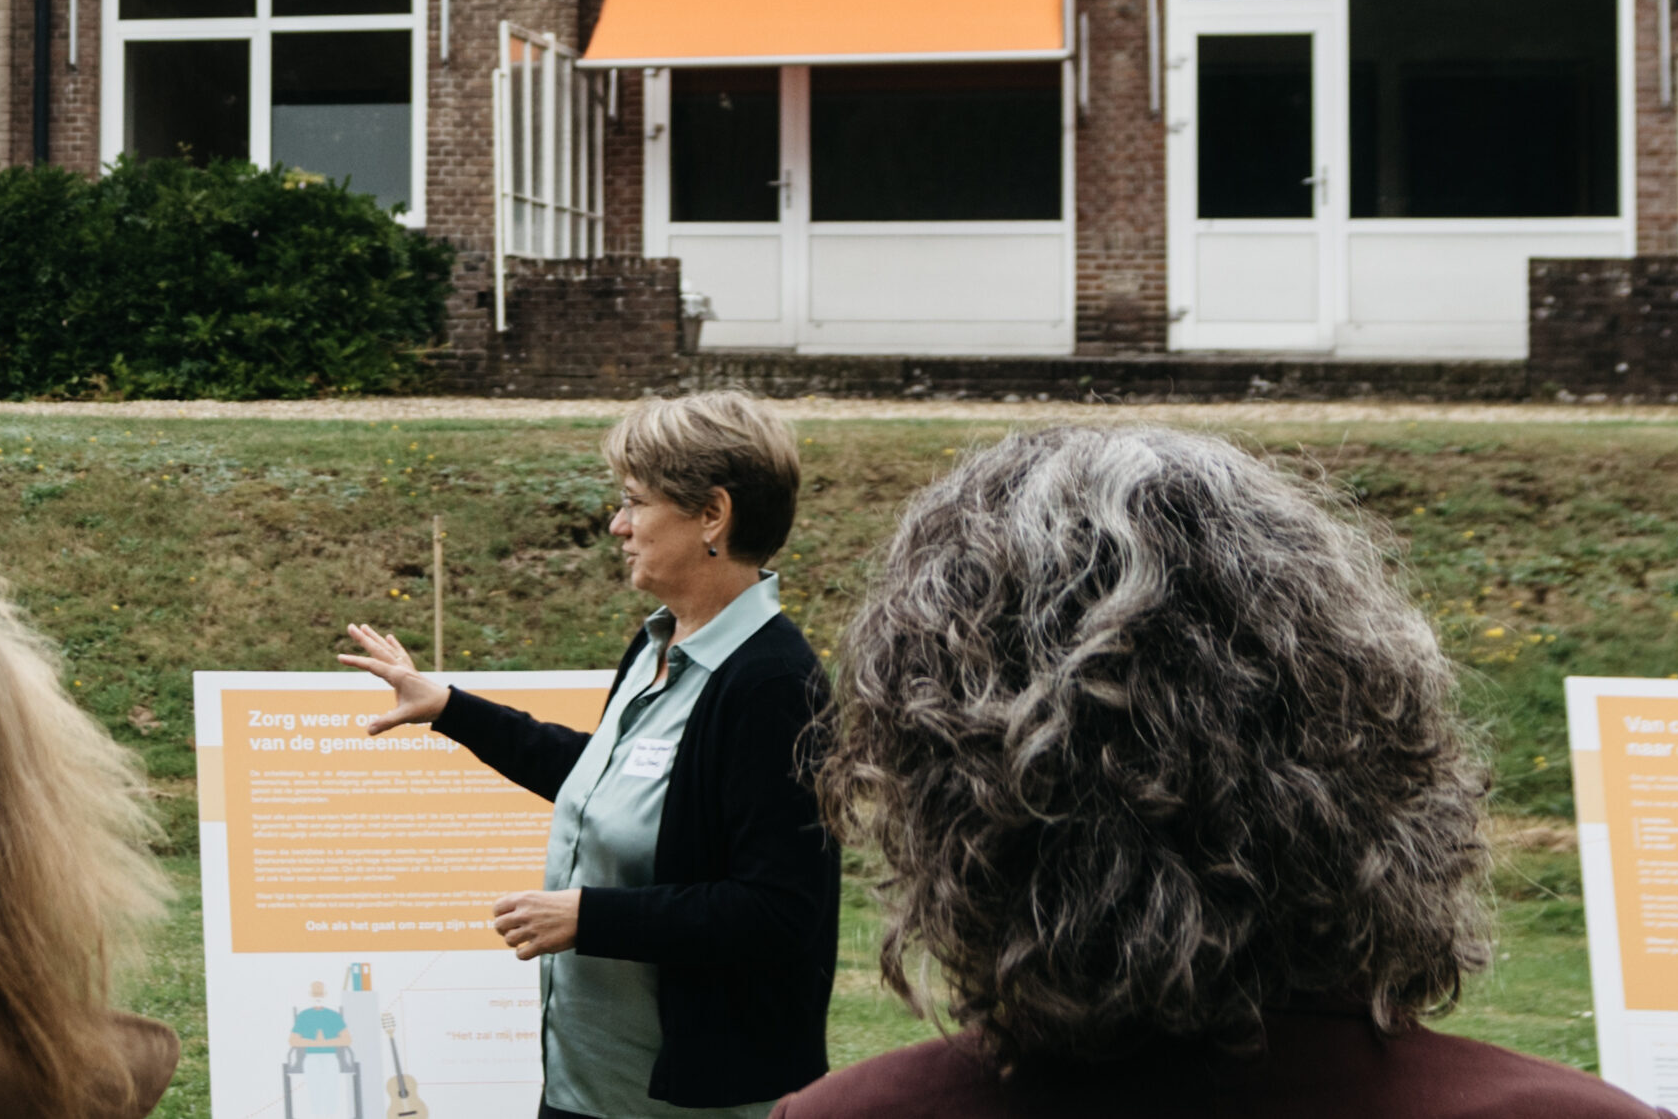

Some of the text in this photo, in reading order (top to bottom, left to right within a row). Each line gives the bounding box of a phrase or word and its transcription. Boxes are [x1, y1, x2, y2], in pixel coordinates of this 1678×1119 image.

[247, 709, 295, 730] Zorg
[300, 712, 351, 727] weer
[1623, 716, 1666, 733] Van
[249, 733, 461, 754] van de gemeenschap
[1625, 742, 1674, 757] naar
[305, 920, 329, 931] Ook
[331, 920, 348, 931] als
[350, 919, 368, 930] het
[371, 919, 396, 932] gaat
[398, 920, 415, 930] om
[418, 920, 443, 932] zorg
[445, 919, 465, 932] zijn
[467, 920, 484, 929] we
